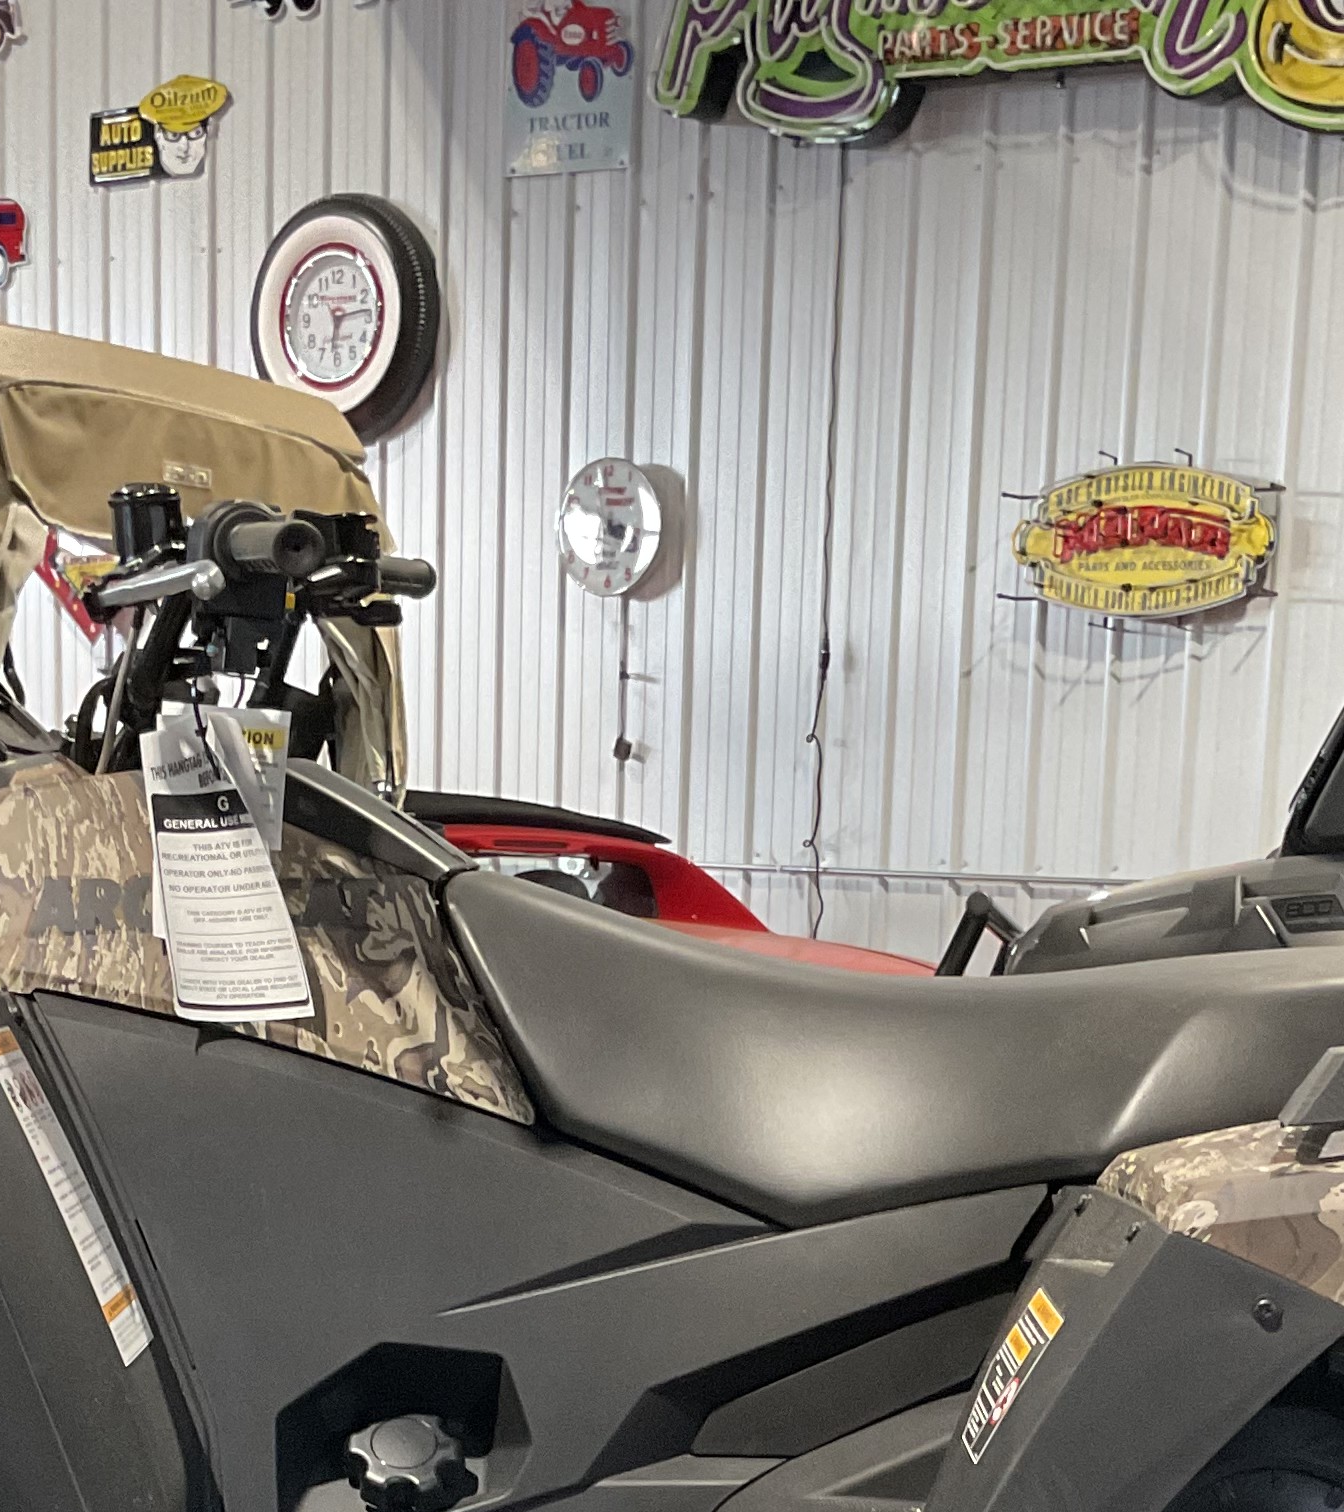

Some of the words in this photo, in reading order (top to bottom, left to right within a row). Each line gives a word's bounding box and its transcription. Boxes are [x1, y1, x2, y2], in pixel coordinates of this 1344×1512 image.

[150, 85, 217, 109] Oilzum
[529, 111, 610, 133] TRACTOR
[99, 119, 142, 147] AUTO
[91, 146, 154, 176] SUPPLIES
[318, 276, 329, 291] 11
[332, 269, 344, 285] 12
[360, 289, 369, 304] 2
[302, 313, 311, 328] 9
[308, 334, 316, 349] 8
[359, 331, 367, 343] 4
[319, 348, 328, 363] 7
[333, 353, 342, 367] 6
[349, 346, 357, 360] 5
[1114, 561, 1136, 571] AND
[1142, 559, 1212, 572] ACCESSORIES
[150, 766, 167, 780] THIS
[168, 756, 203, 777] HANGTAG
[217, 795, 230, 812] G
[163, 817, 219, 830] GENERAL
[192, 842, 213, 852] THIS
[215, 841, 231, 850] ATV
[161, 852, 228, 862] RECREATIONAL
[229, 851, 242, 860] OR
[163, 868, 205, 878] OPERATOR
[169, 884, 181, 892] NO
[182, 884, 231, 893] OPERATOR
[232, 881, 261, 892] UNDER
